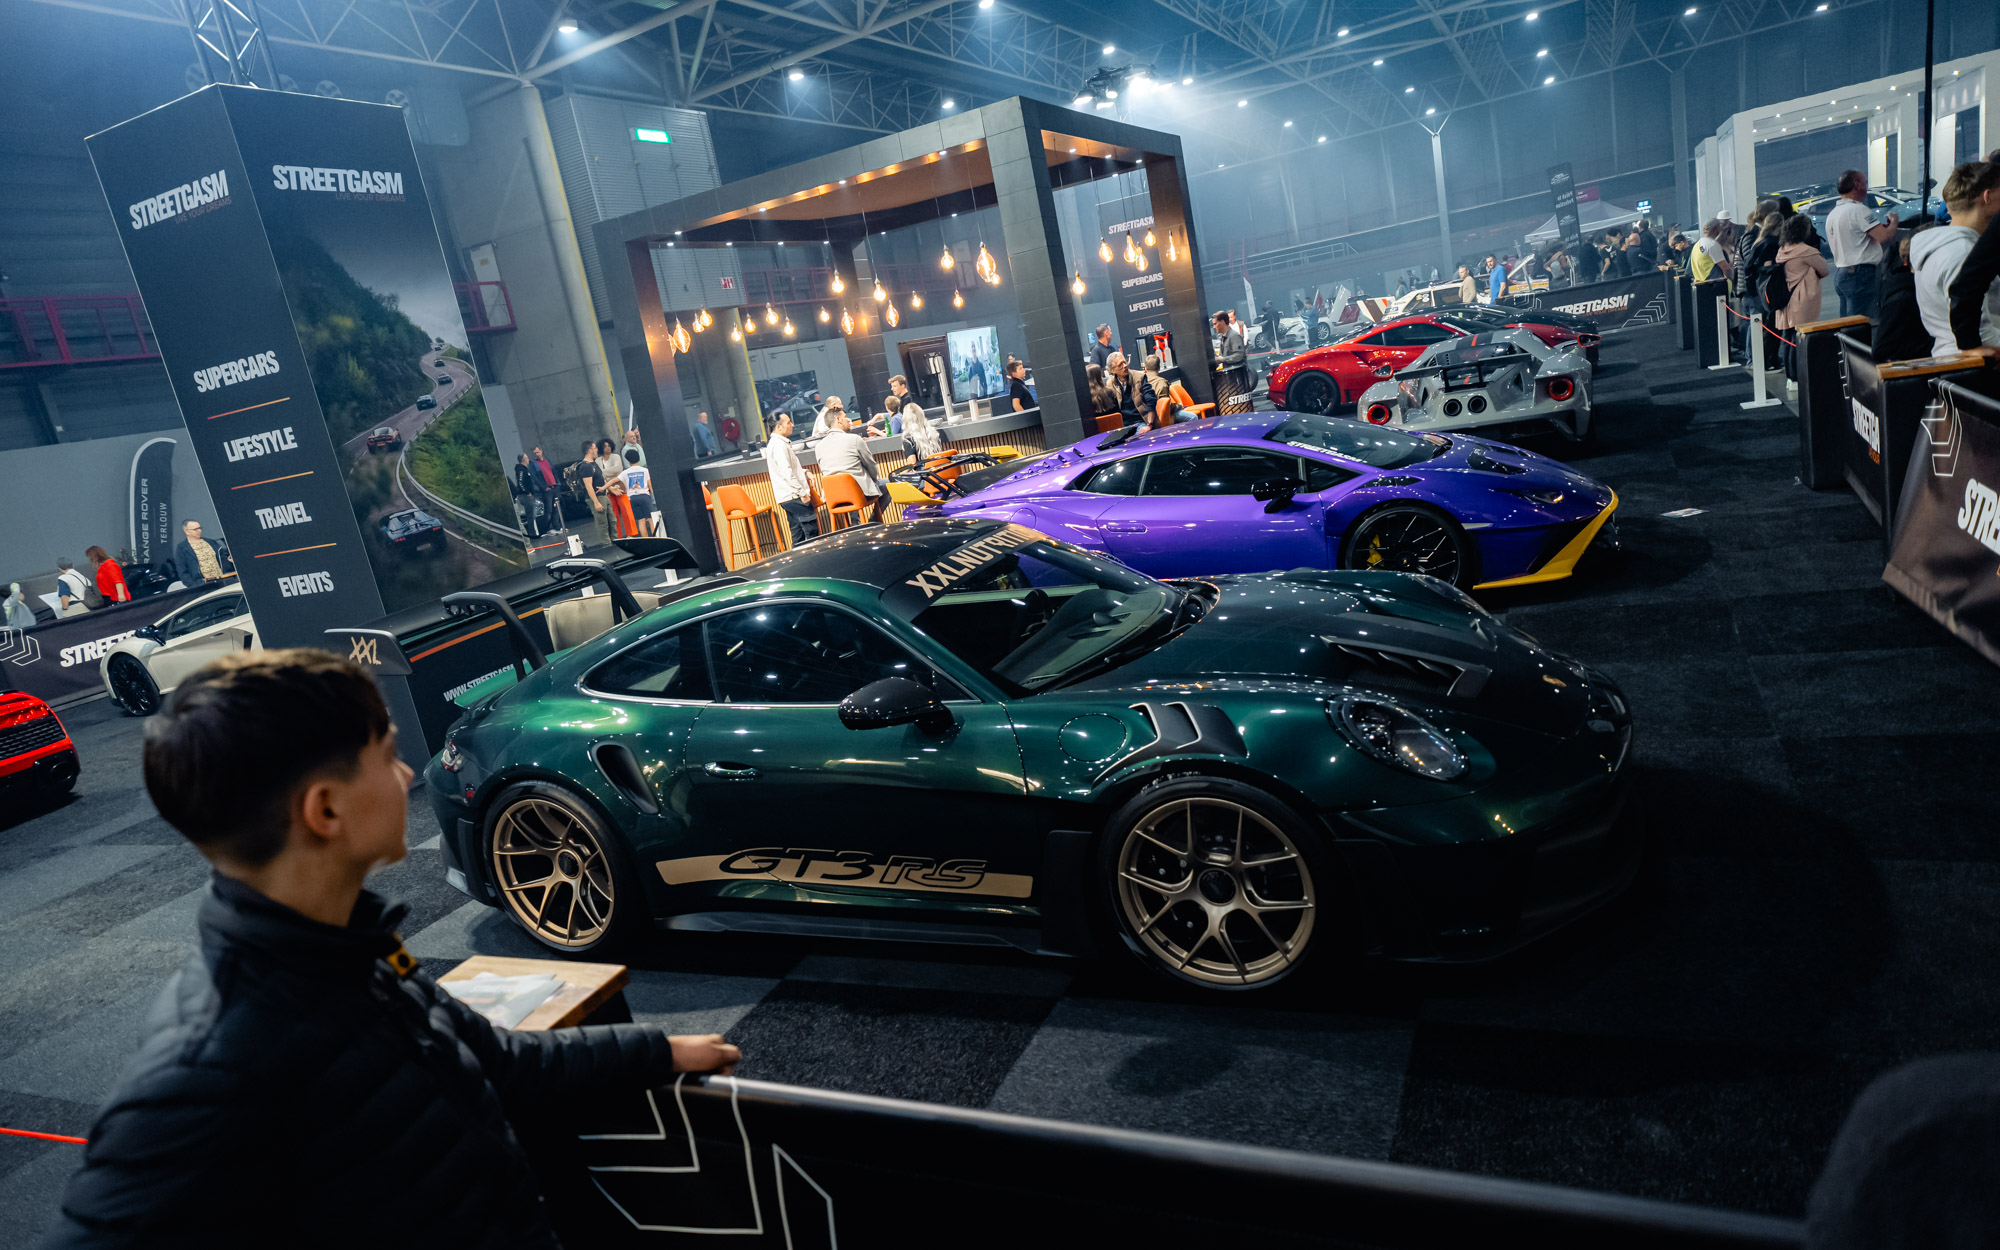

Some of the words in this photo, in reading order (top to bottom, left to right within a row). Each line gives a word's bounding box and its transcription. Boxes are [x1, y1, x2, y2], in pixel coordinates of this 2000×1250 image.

[272, 164, 404, 195] STREETGASM
[129, 169, 229, 230] STREETGASM
[189, 206, 205, 218] YOUR
[206, 197, 232, 213] DREAMS
[335, 192, 352, 200] LIVE
[354, 193, 374, 201] YOUR
[375, 194, 406, 203] DREAMS
[1121, 272, 1164, 289] SUPERCARS
[1129, 297, 1164, 313] LIFESTYLE
[1137, 323, 1164, 336] TRAVEL
[193, 350, 280, 393] SUPERCARS
[223, 426, 298, 463] LIFESTYLE
[141, 478, 149, 520] ROVER
[160, 502, 168, 544] TERLOUW
[255, 501, 313, 530] TRAVEL
[277, 570, 335, 598] EVENTS
[349, 636, 382, 665] XXL
[718, 846, 874, 881] GT3
[878, 854, 989, 890] RS
